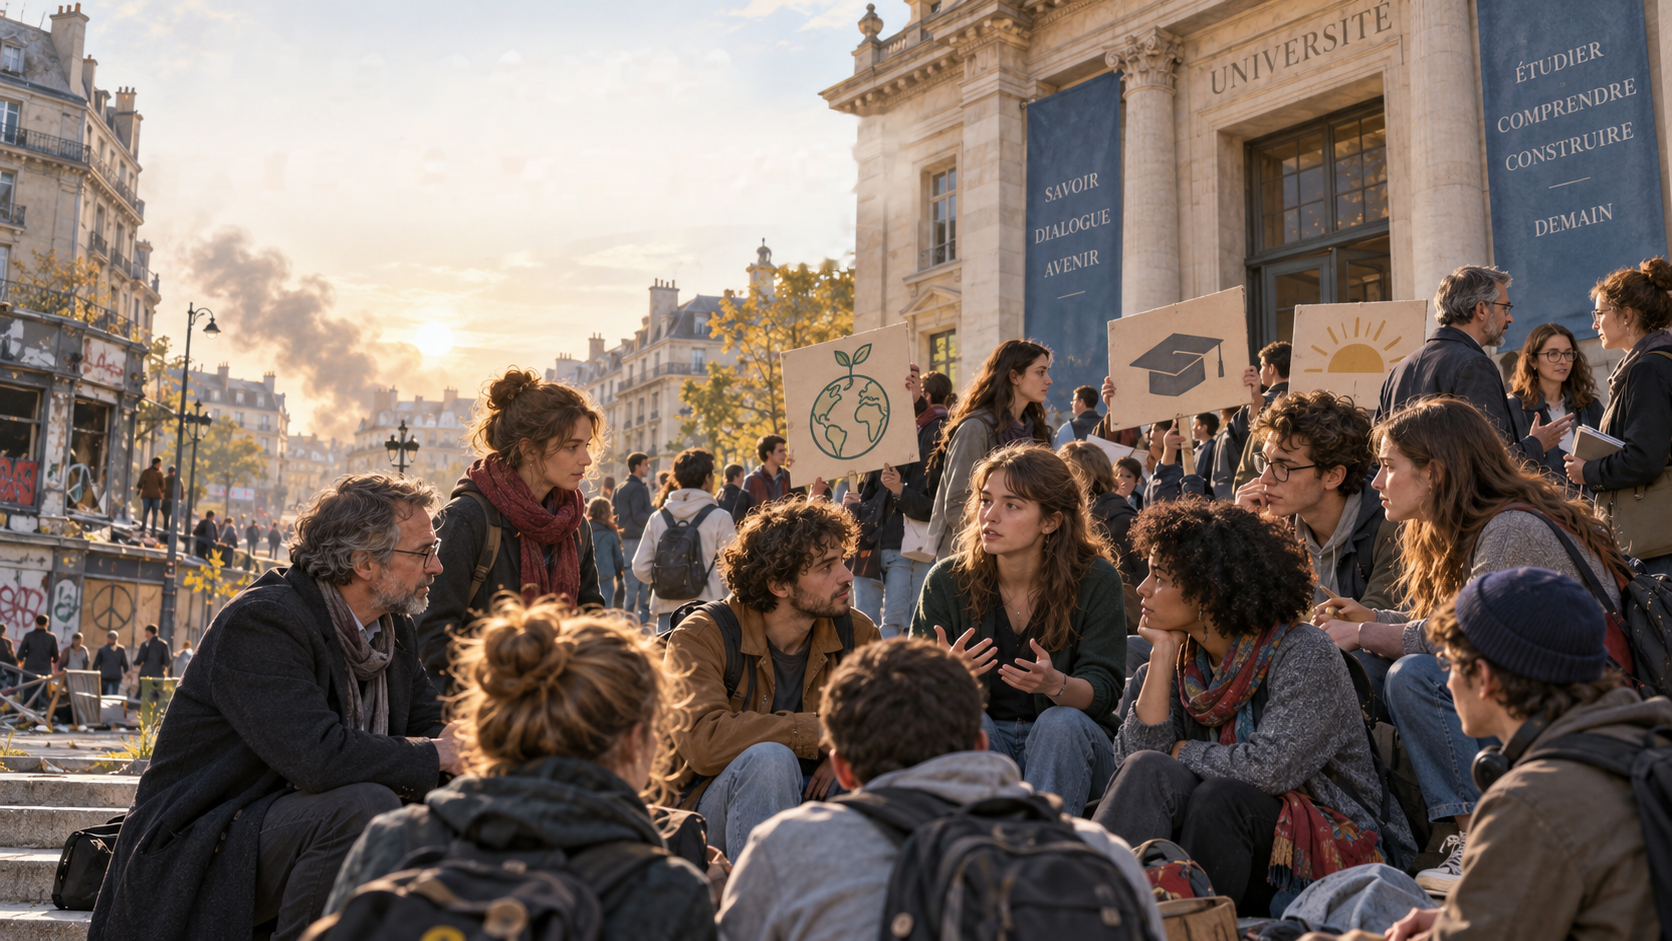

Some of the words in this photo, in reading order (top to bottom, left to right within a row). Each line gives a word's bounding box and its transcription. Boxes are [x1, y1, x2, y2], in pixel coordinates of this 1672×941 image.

[1210, 0, 1392, 95] UNIVERSITÉ
[1515, 41, 1604, 84] ÉTUDIER
[1497, 77, 1637, 133] COMPRENDRE
[1505, 121, 1634, 171] CONSTRUIRE
[1045, 172, 1099, 203] SAVOIR
[1035, 208, 1111, 244] DIALOGUE
[1534, 202, 1613, 237] DEMAIN
[1044, 249, 1100, 278] AVENIR
